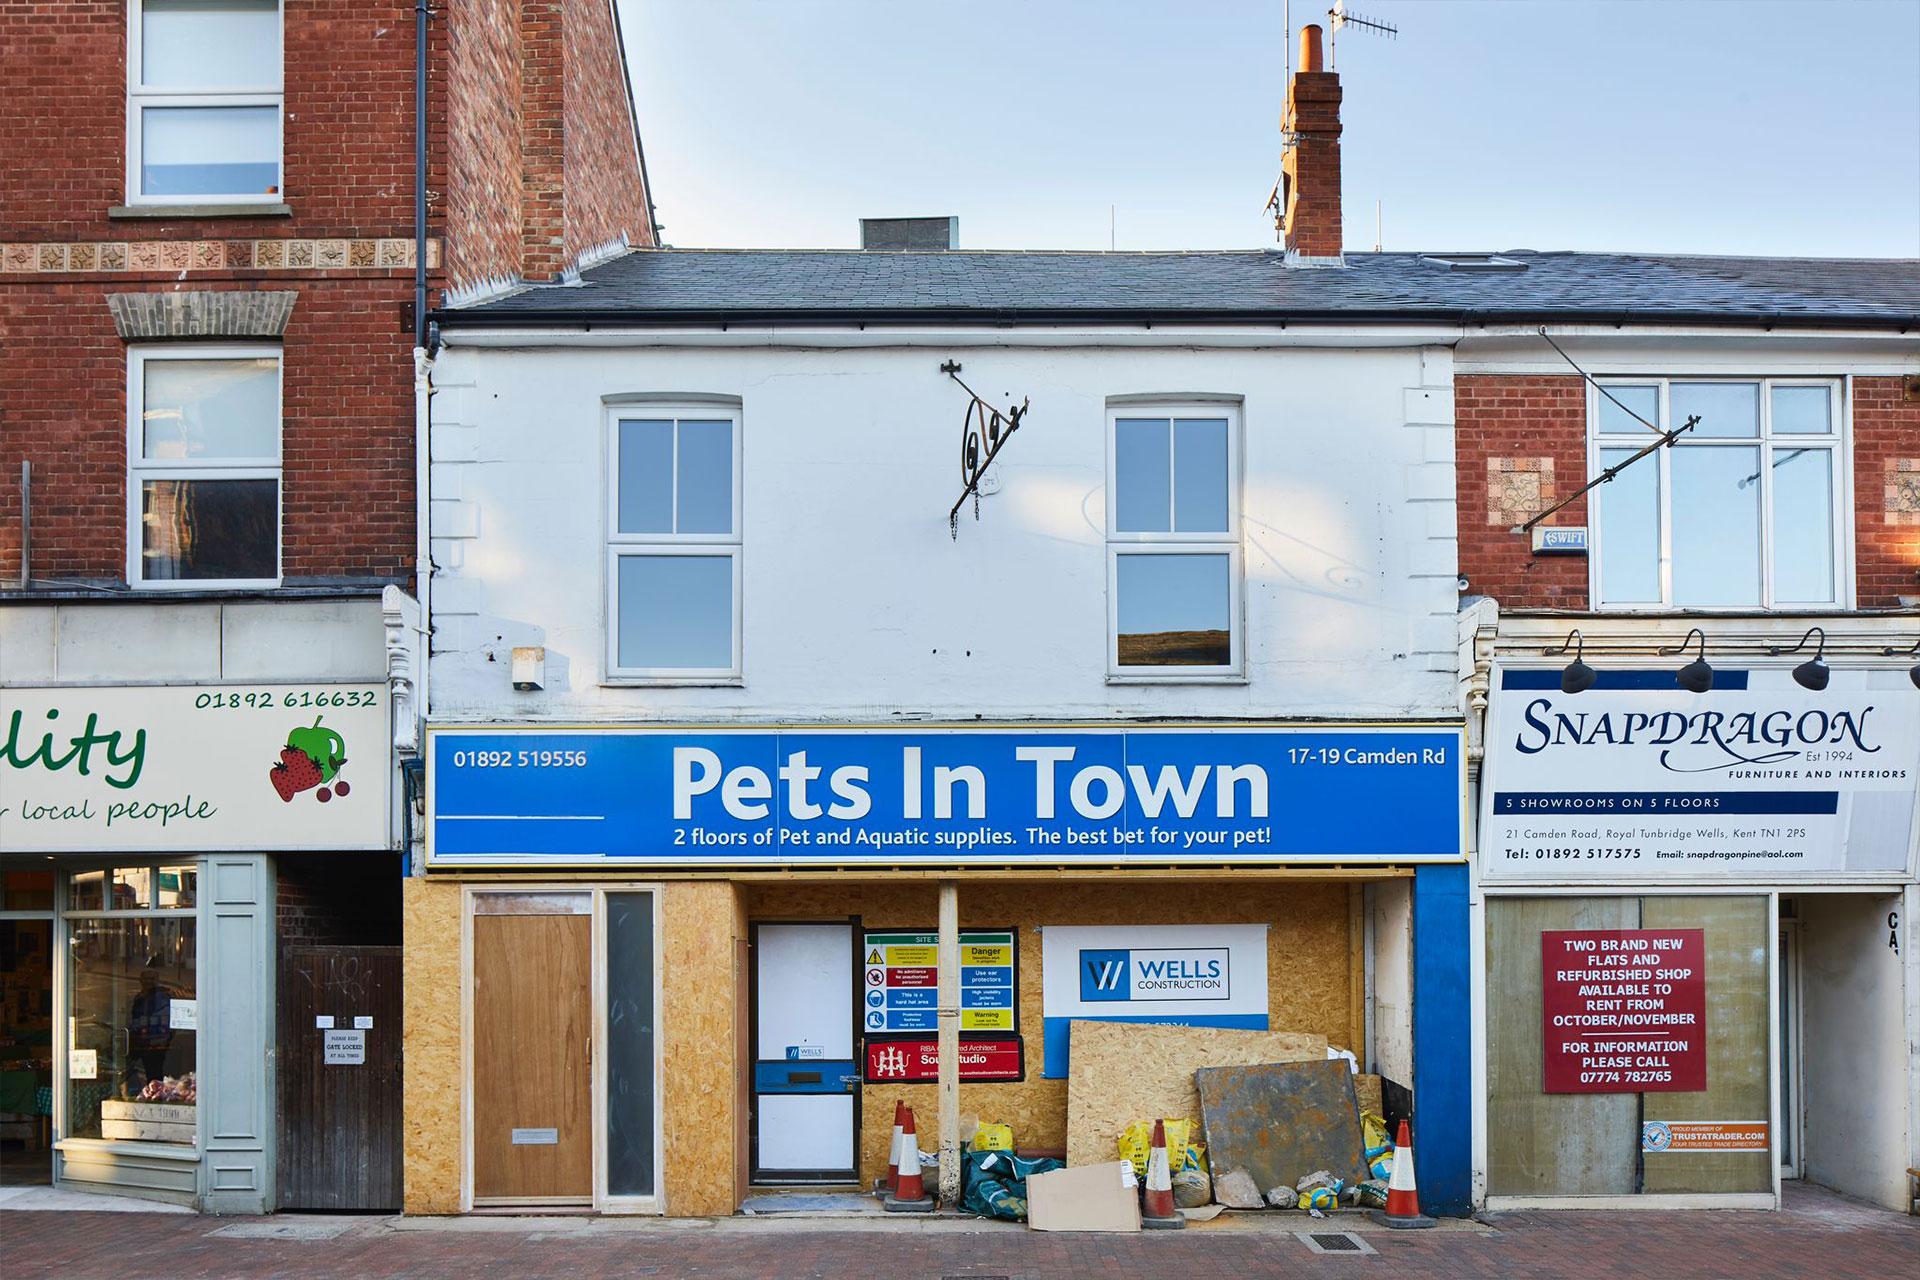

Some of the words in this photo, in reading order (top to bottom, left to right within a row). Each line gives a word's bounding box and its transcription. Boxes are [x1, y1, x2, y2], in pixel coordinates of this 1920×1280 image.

[1551, 531, 1584, 543] SWIFT
[195, 691, 274, 709] 01892
[283, 691, 377, 708] 616632
[1515, 698, 1882, 772] SNAPDRAGON
[0, 708, 146, 789] lity
[453, 750, 513, 768] 01892
[517, 750, 587, 768] 519556
[1288, 748, 1340, 765] 17-19
[1344, 747, 1418, 765] Camden
[1422, 747, 1445, 765] Rd
[1806, 751, 1820, 762] Est
[1825, 751, 1853, 762] 1994
[1728, 770, 1799, 779] FURNITURE
[1805, 770, 1832, 779] AND
[1838, 770, 1907, 779] INTERIORS
[673, 746, 872, 821] Pets
[903, 746, 986, 820] In
[1015, 745, 1270, 820] Town
[1506, 799, 1513, 808] 5
[1520, 798, 1614, 808] SHOWROOMS
[1621, 798, 1643, 808] ON
[1650, 798, 1657, 808] 5
[1664, 798, 1720, 808] FLOORS
[22, 799, 96, 820] local
[107, 794, 218, 827] people
[674, 828, 685, 845] 2
[691, 827, 748, 845] floors
[753, 827, 774, 845] of
[780, 828, 811, 845] Pet
[816, 827, 851, 845] and
[855, 828, 929, 849] Aquatic
[935, 827, 1017, 849] supplies.
[1026, 827, 1061, 845] The
[1066, 827, 1107, 845] best
[1113, 827, 1145, 844] bet
[1150, 827, 1179, 844] for
[1183, 829, 1228, 848] your
[1233, 827, 1271, 848] pet!
[1506, 829, 1518, 839] 21
[1524, 829, 1567, 839] Camden
[1571, 828, 1601, 840] Road,
[1606, 828, 1636, 841] Royal
[1640, 828, 1692, 841] Tunbridge
[1696, 828, 1728, 840] Wells,
[1733, 829, 1757, 838] Kent
[1760, 829, 1780, 838] TN1
[1786, 829, 1806, 838] 2PS
[1505, 848, 1529, 859] Tel:
[1535, 848, 1581, 859] 01892
[1587, 848, 1641, 859] 517575
[1656, 850, 1684, 859] Email:
[1687, 850, 1803, 861] snapdragonpine@aol.com
[1887, 911, 1899, 956] CA
[1563, 940, 1596, 951] TWO
[1600, 939, 1648, 951] BRAND
[1652, 939, 1684, 950] NEW
[971, 947, 1001, 956] Danger
[1587, 955, 1628, 966] FLATS
[1632, 954, 1661, 965] AND
[1137, 959, 1220, 979] WELLS
[1556, 969, 1652, 981] REFURBISHED
[1655, 968, 1692, 980] SHOP
[1137, 980, 1221, 990] CONSTRUCTION
[1578, 984, 1650, 996] AVAILABLE
[1653, 984, 1672, 995] TO
[1586, 999, 1622, 1011] RENT
[1627, 999, 1664, 1010] FROM
[1553, 1013, 1696, 1027] OCTOBER/NOVEMBER
[1562, 1042, 1590, 1053] FOR
[1593, 1041, 1688, 1053] INFORMATION
[1582, 1056, 1632, 1068] PLEASE
[1636, 1056, 1669, 1067] CALL
[1580, 1072, 1620, 1083] 07774
[1624, 1071, 1672, 1082] 782765
[1672, 1132, 1765, 1140] TRUSTATRADER.COM
